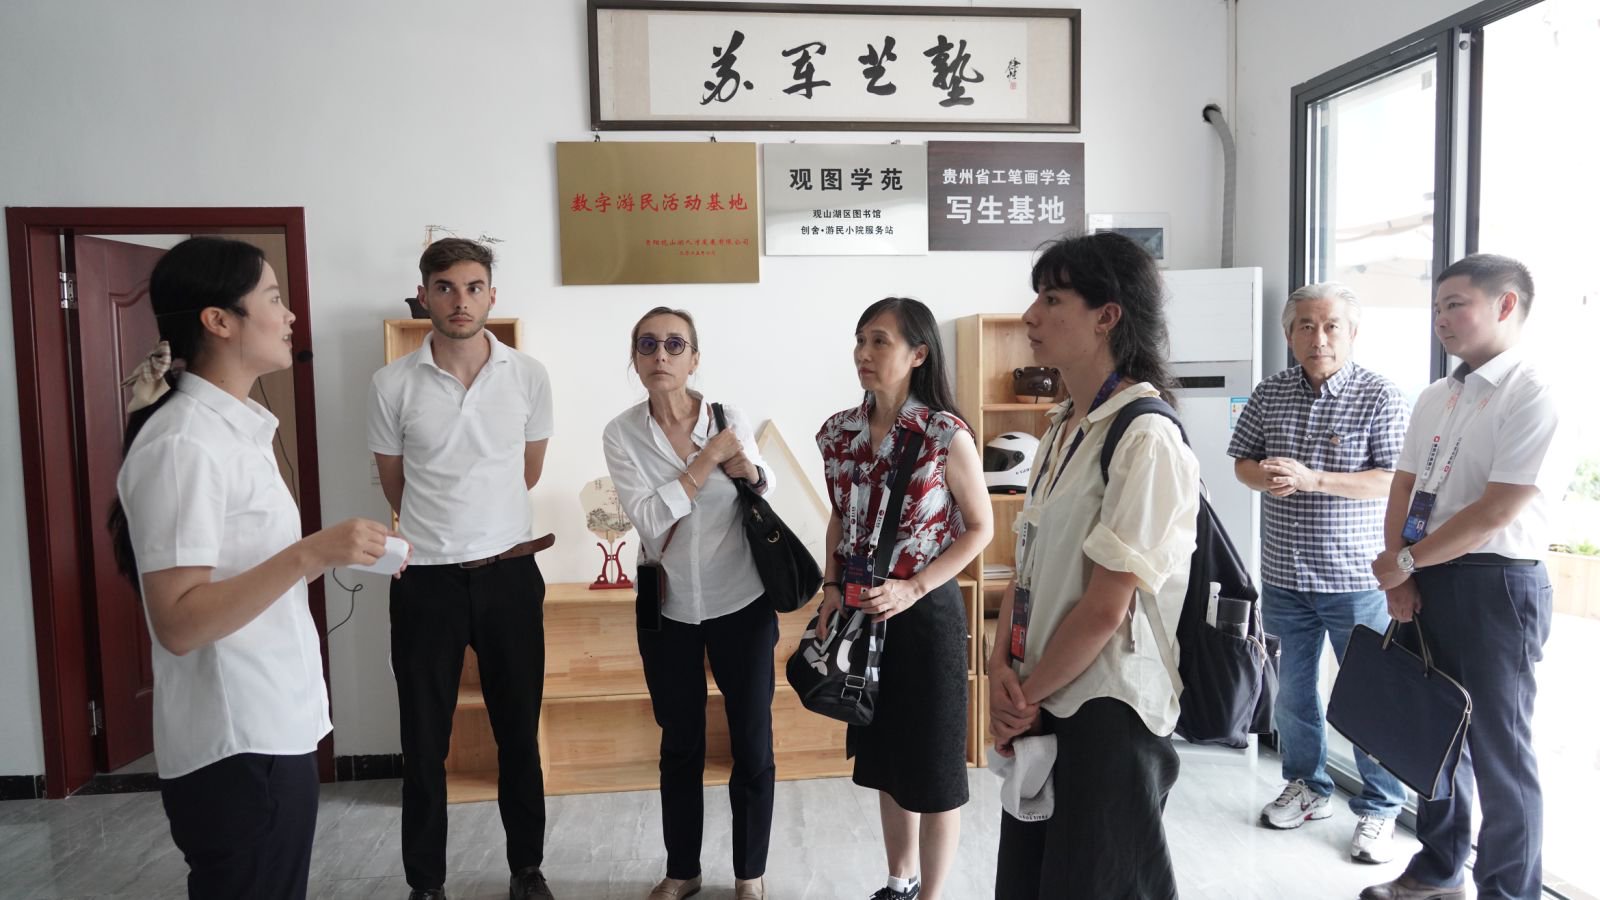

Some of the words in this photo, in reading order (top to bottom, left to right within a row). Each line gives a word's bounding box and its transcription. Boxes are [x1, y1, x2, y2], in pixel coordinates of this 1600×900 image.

[789, 167, 903, 191] 观图学苑
[942, 168, 1071, 186] 贵州省工笔画学会
[570, 191, 749, 214] 数字游民活动基地
[812, 208, 882, 219] 观山湖区图书馆
[946, 195, 1066, 225] 写生基地
